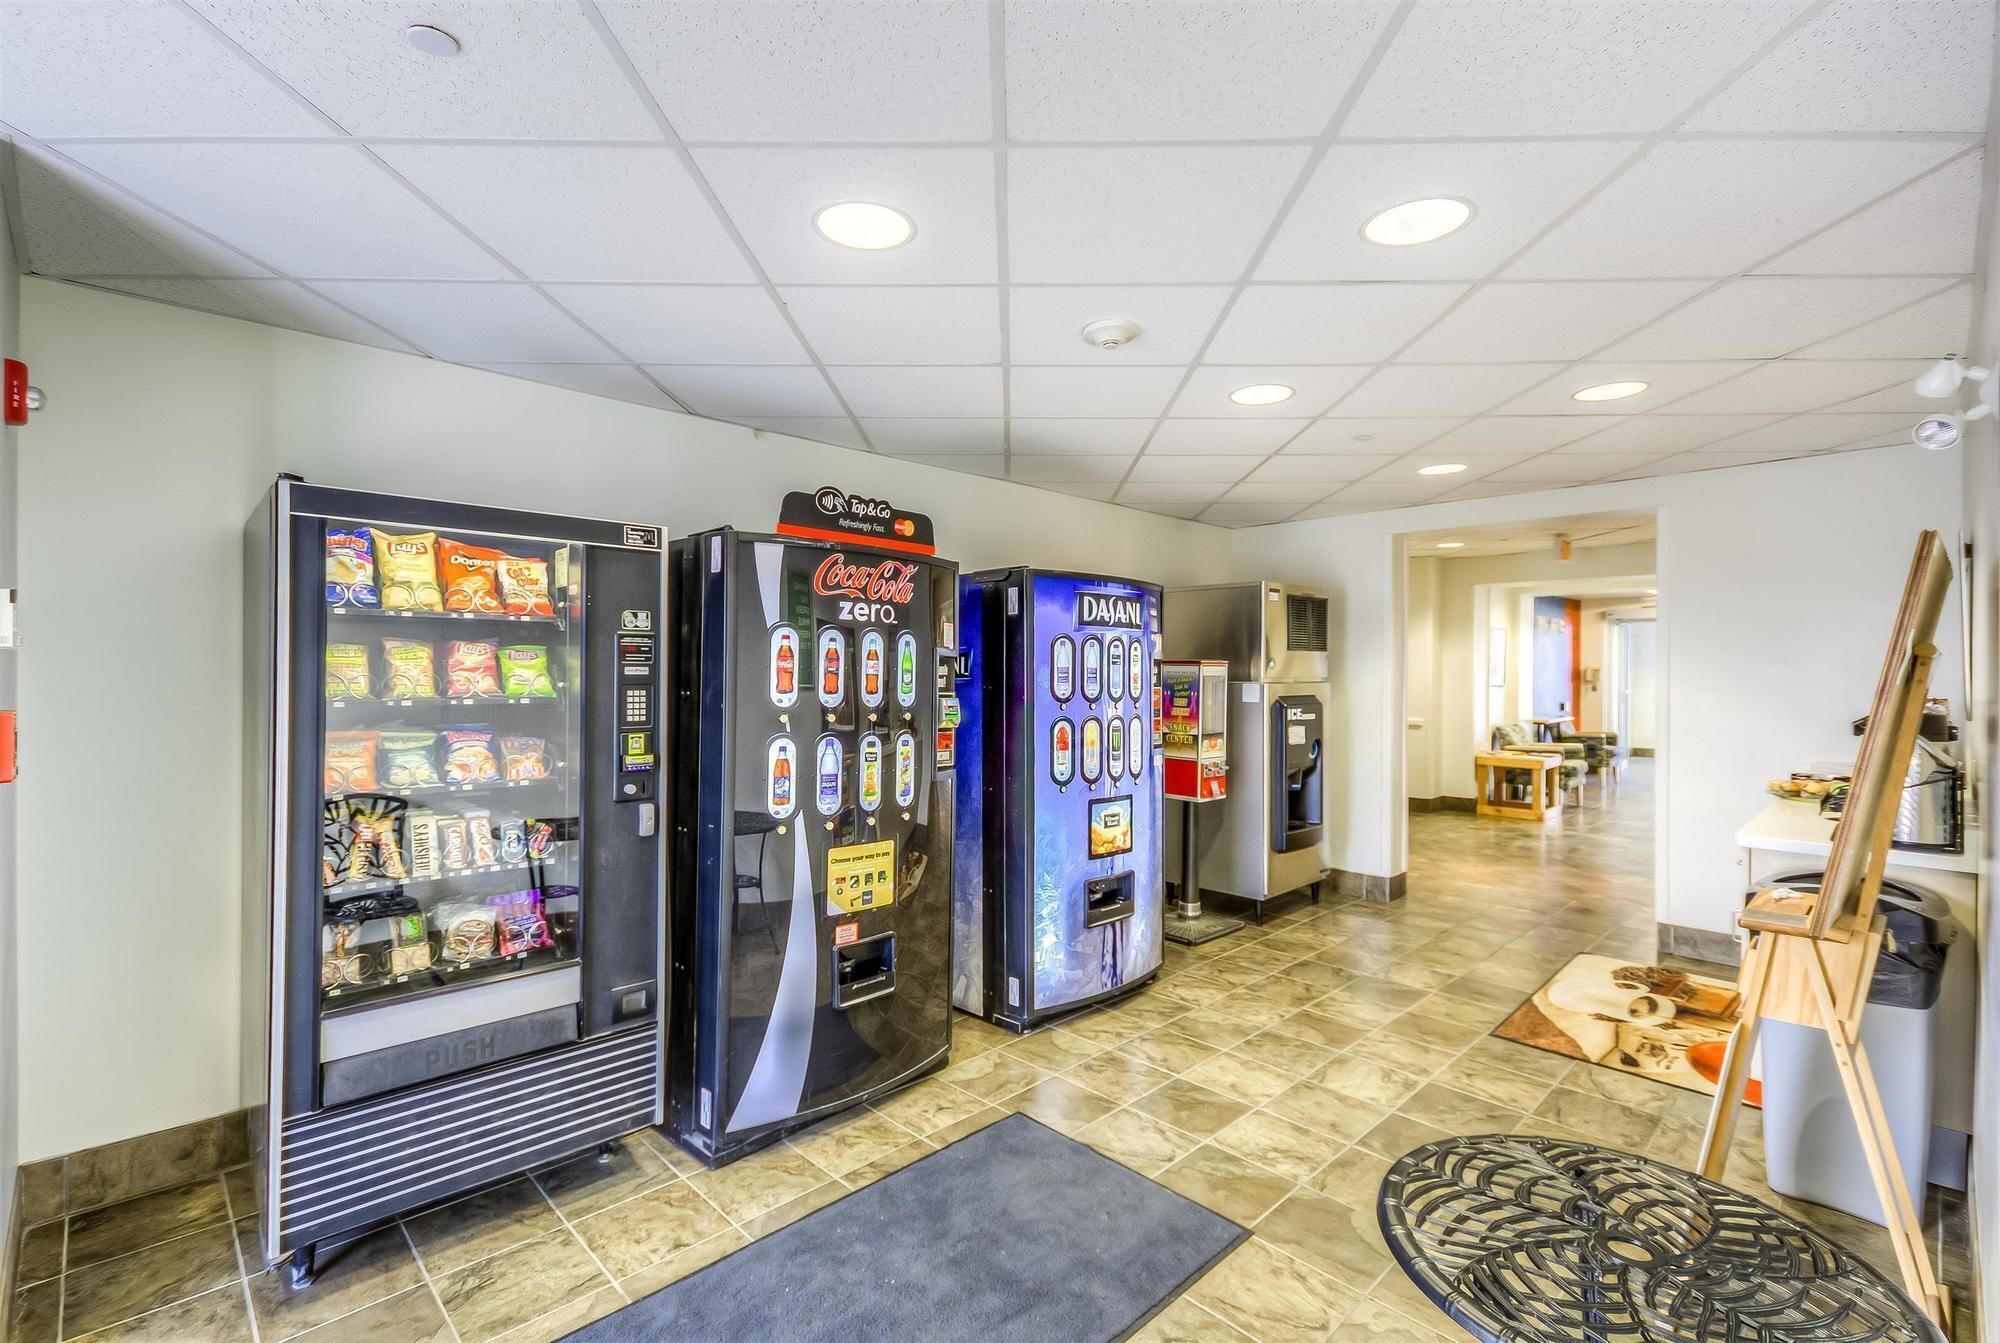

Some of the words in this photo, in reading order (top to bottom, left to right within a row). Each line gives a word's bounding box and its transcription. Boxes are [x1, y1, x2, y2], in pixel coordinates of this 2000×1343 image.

[839, 601, 896, 624] zero
[1083, 596, 1142, 626] DASANI
[1287, 708, 1303, 720] ICE
[1169, 723, 1192, 732] SNACK
[1166, 734, 1194, 744] CENTER
[425, 1035, 495, 1075] PUSH
